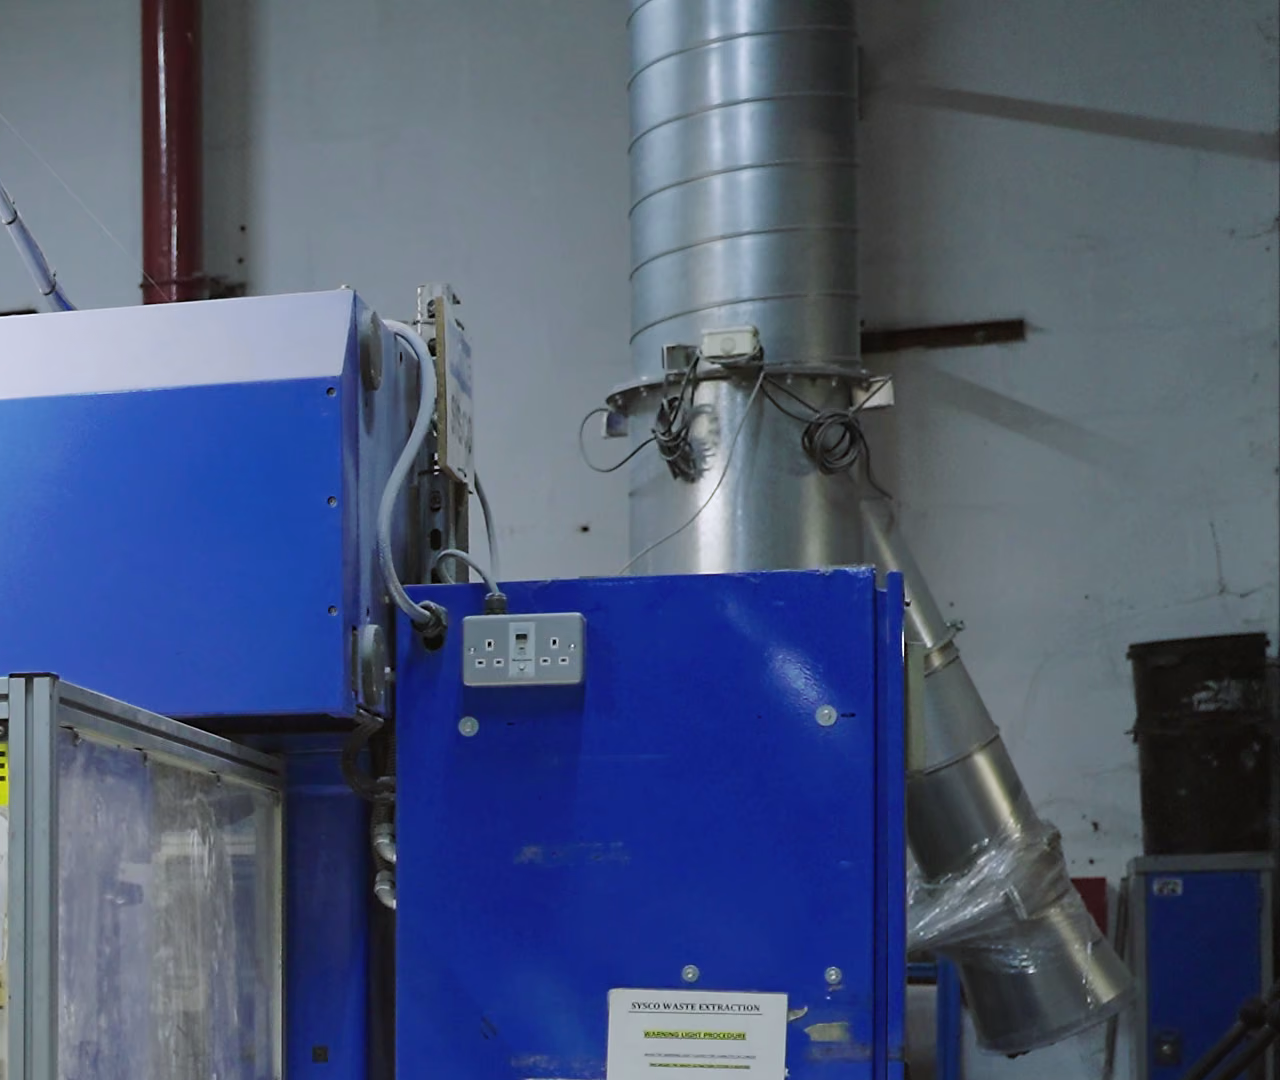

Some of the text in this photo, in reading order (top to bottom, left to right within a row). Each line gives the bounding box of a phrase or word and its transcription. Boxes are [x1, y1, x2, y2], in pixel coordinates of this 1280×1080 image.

[631, 1001, 761, 1013] SYSCO WASTE EXTRACTION
[644, 1030, 746, 1040] WARNING LIGHT PROCEDURE
